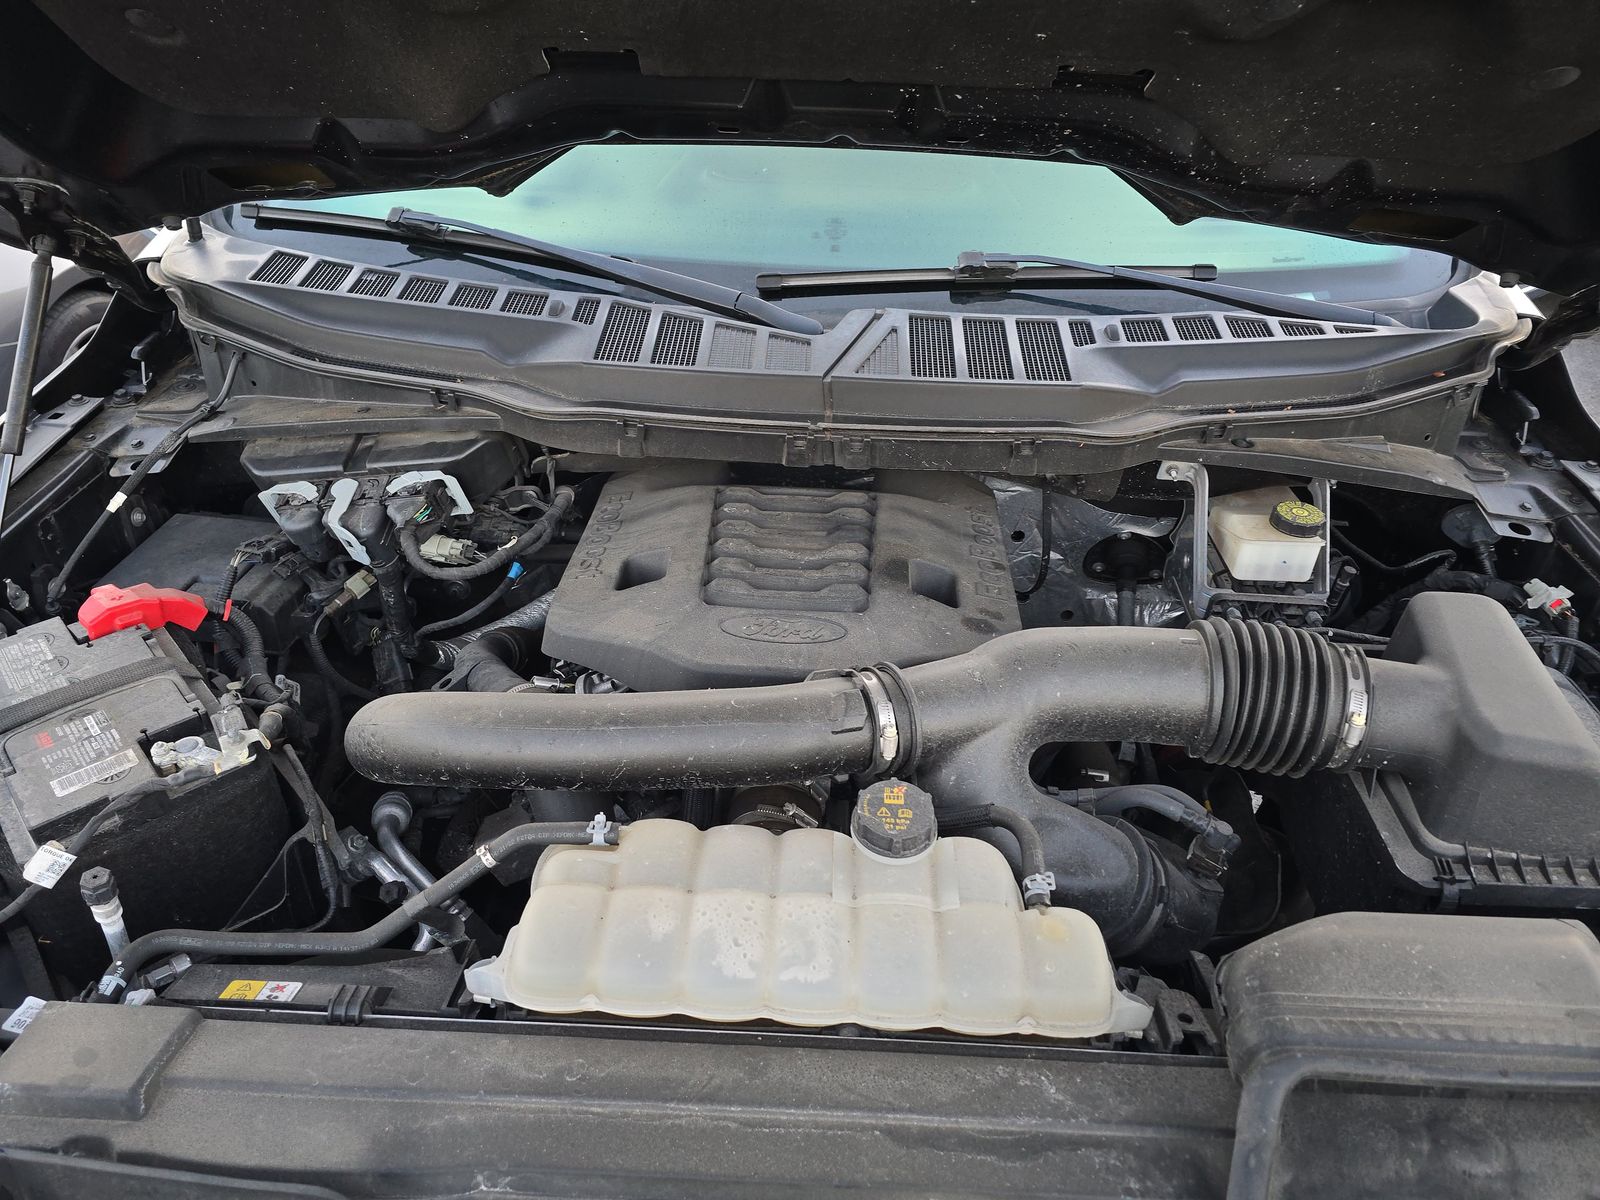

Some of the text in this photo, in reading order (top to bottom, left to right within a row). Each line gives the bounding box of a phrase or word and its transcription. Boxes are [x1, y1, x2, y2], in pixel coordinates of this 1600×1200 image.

[573, 490, 634, 581] ECOBOOST
[964, 503, 1009, 602] ECOBOOST
[742, 617, 825, 640] Ford
[40, 846, 65, 859] TORQUE
